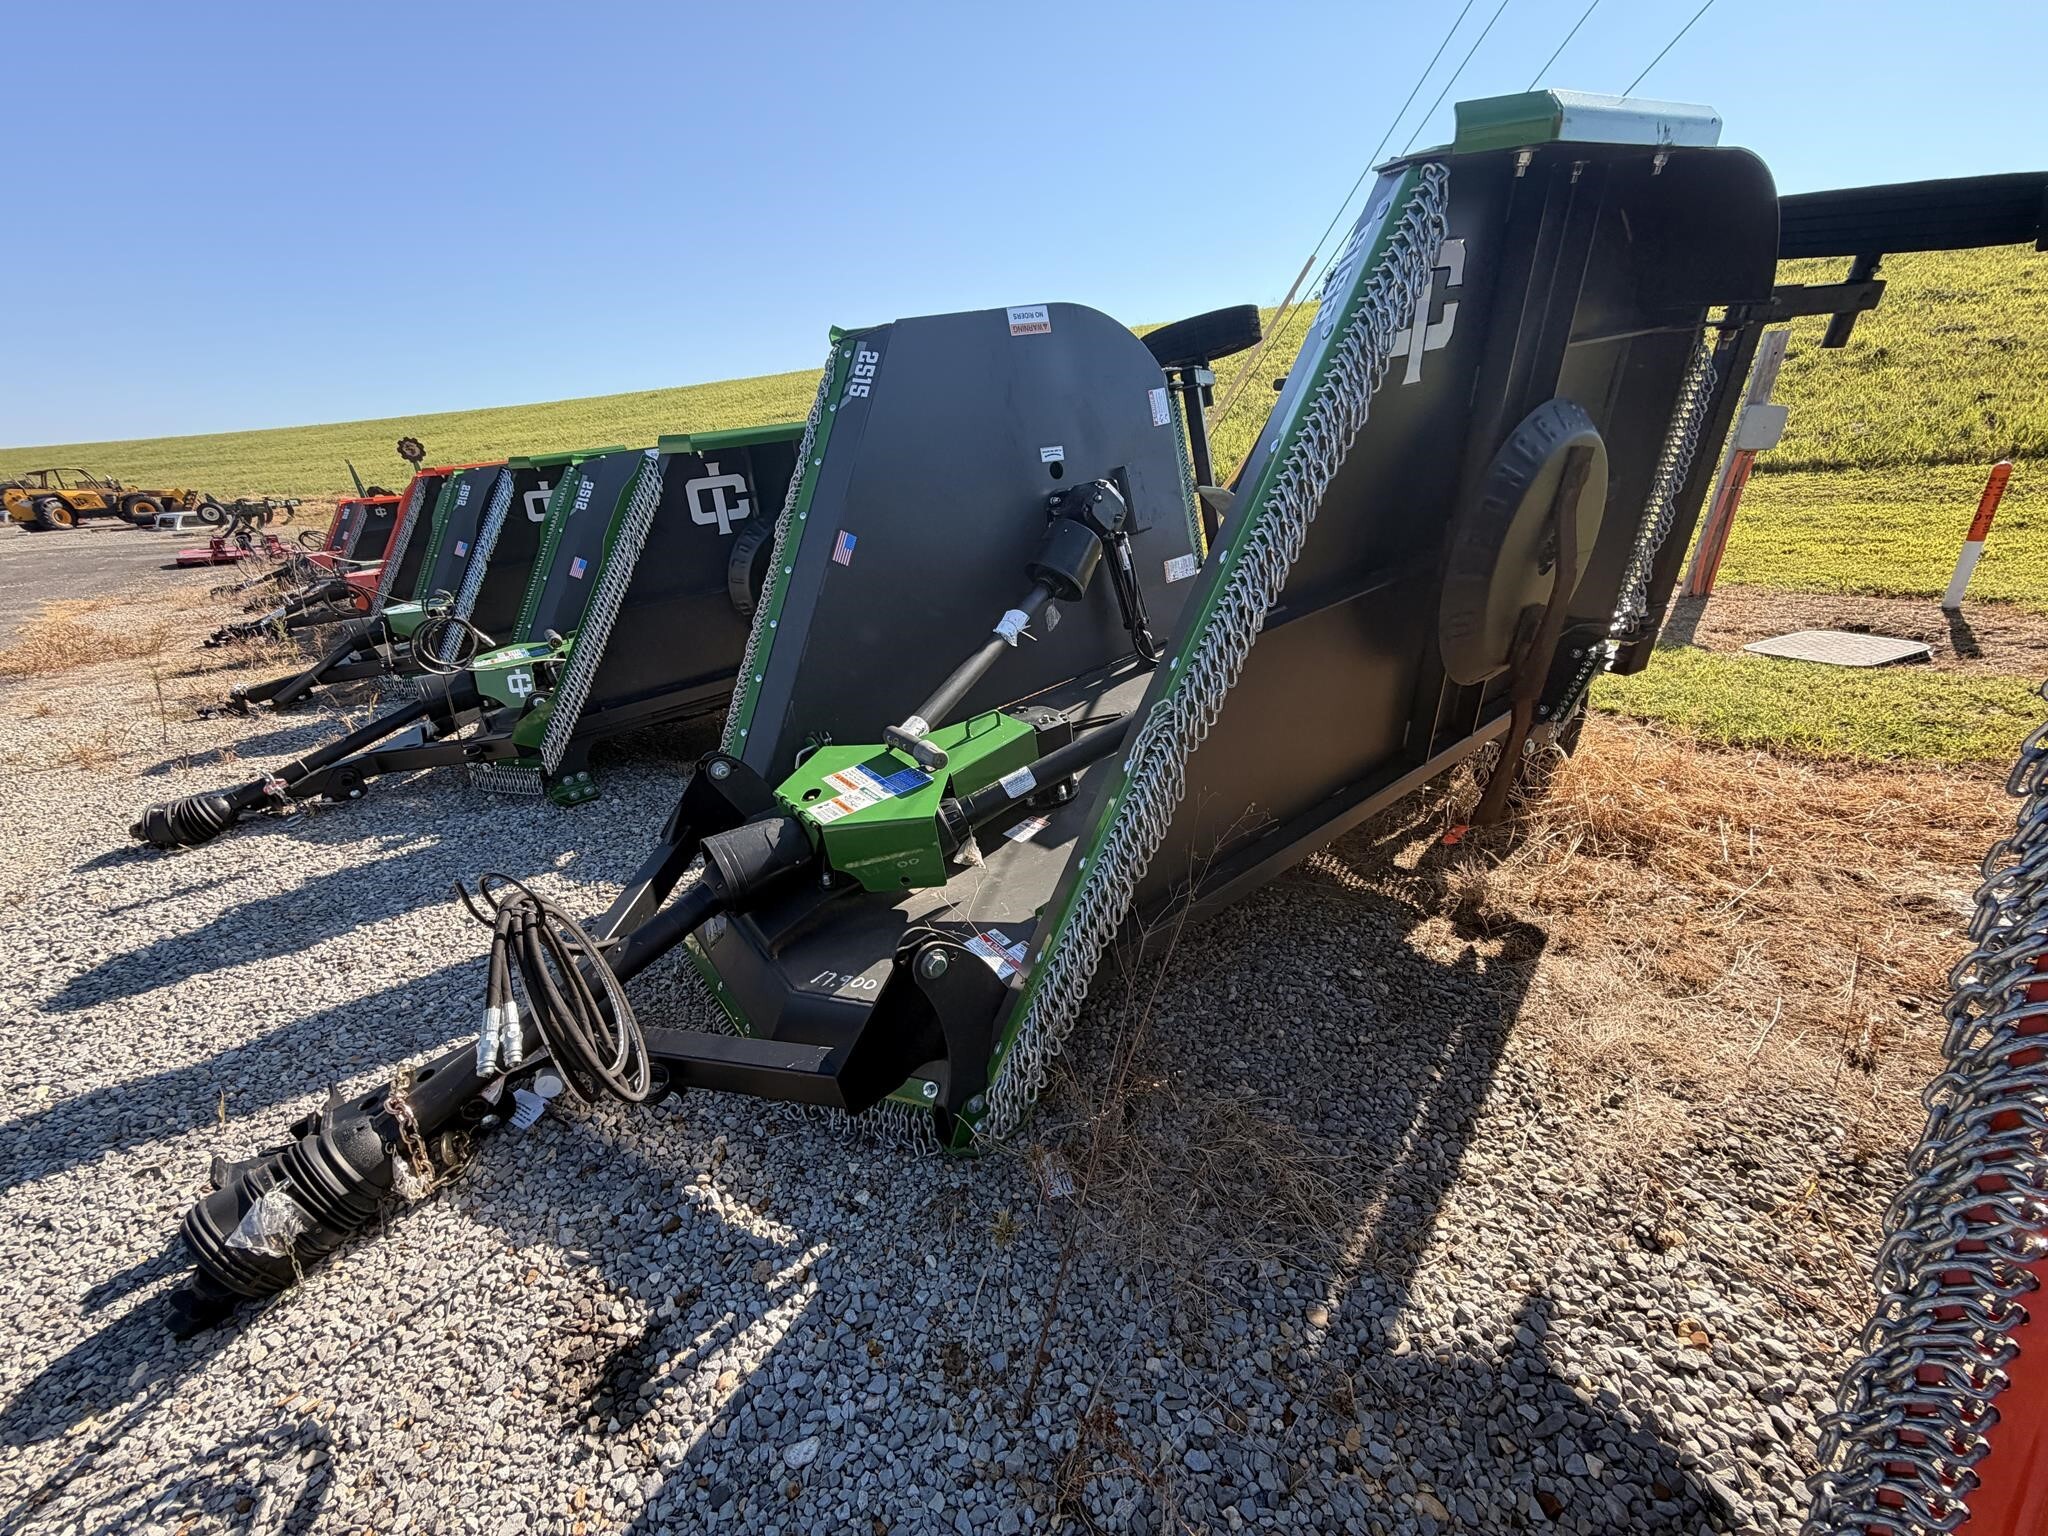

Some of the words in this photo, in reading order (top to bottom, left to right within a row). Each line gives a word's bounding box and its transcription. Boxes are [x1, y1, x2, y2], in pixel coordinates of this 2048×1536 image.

[1012, 312, 1035, 320] RIDERS
[1034, 311, 1044, 319] NO
[1012, 323, 1044, 334] WARNING
[848, 350, 880, 398] 2515
[574, 480, 595, 510] 2512
